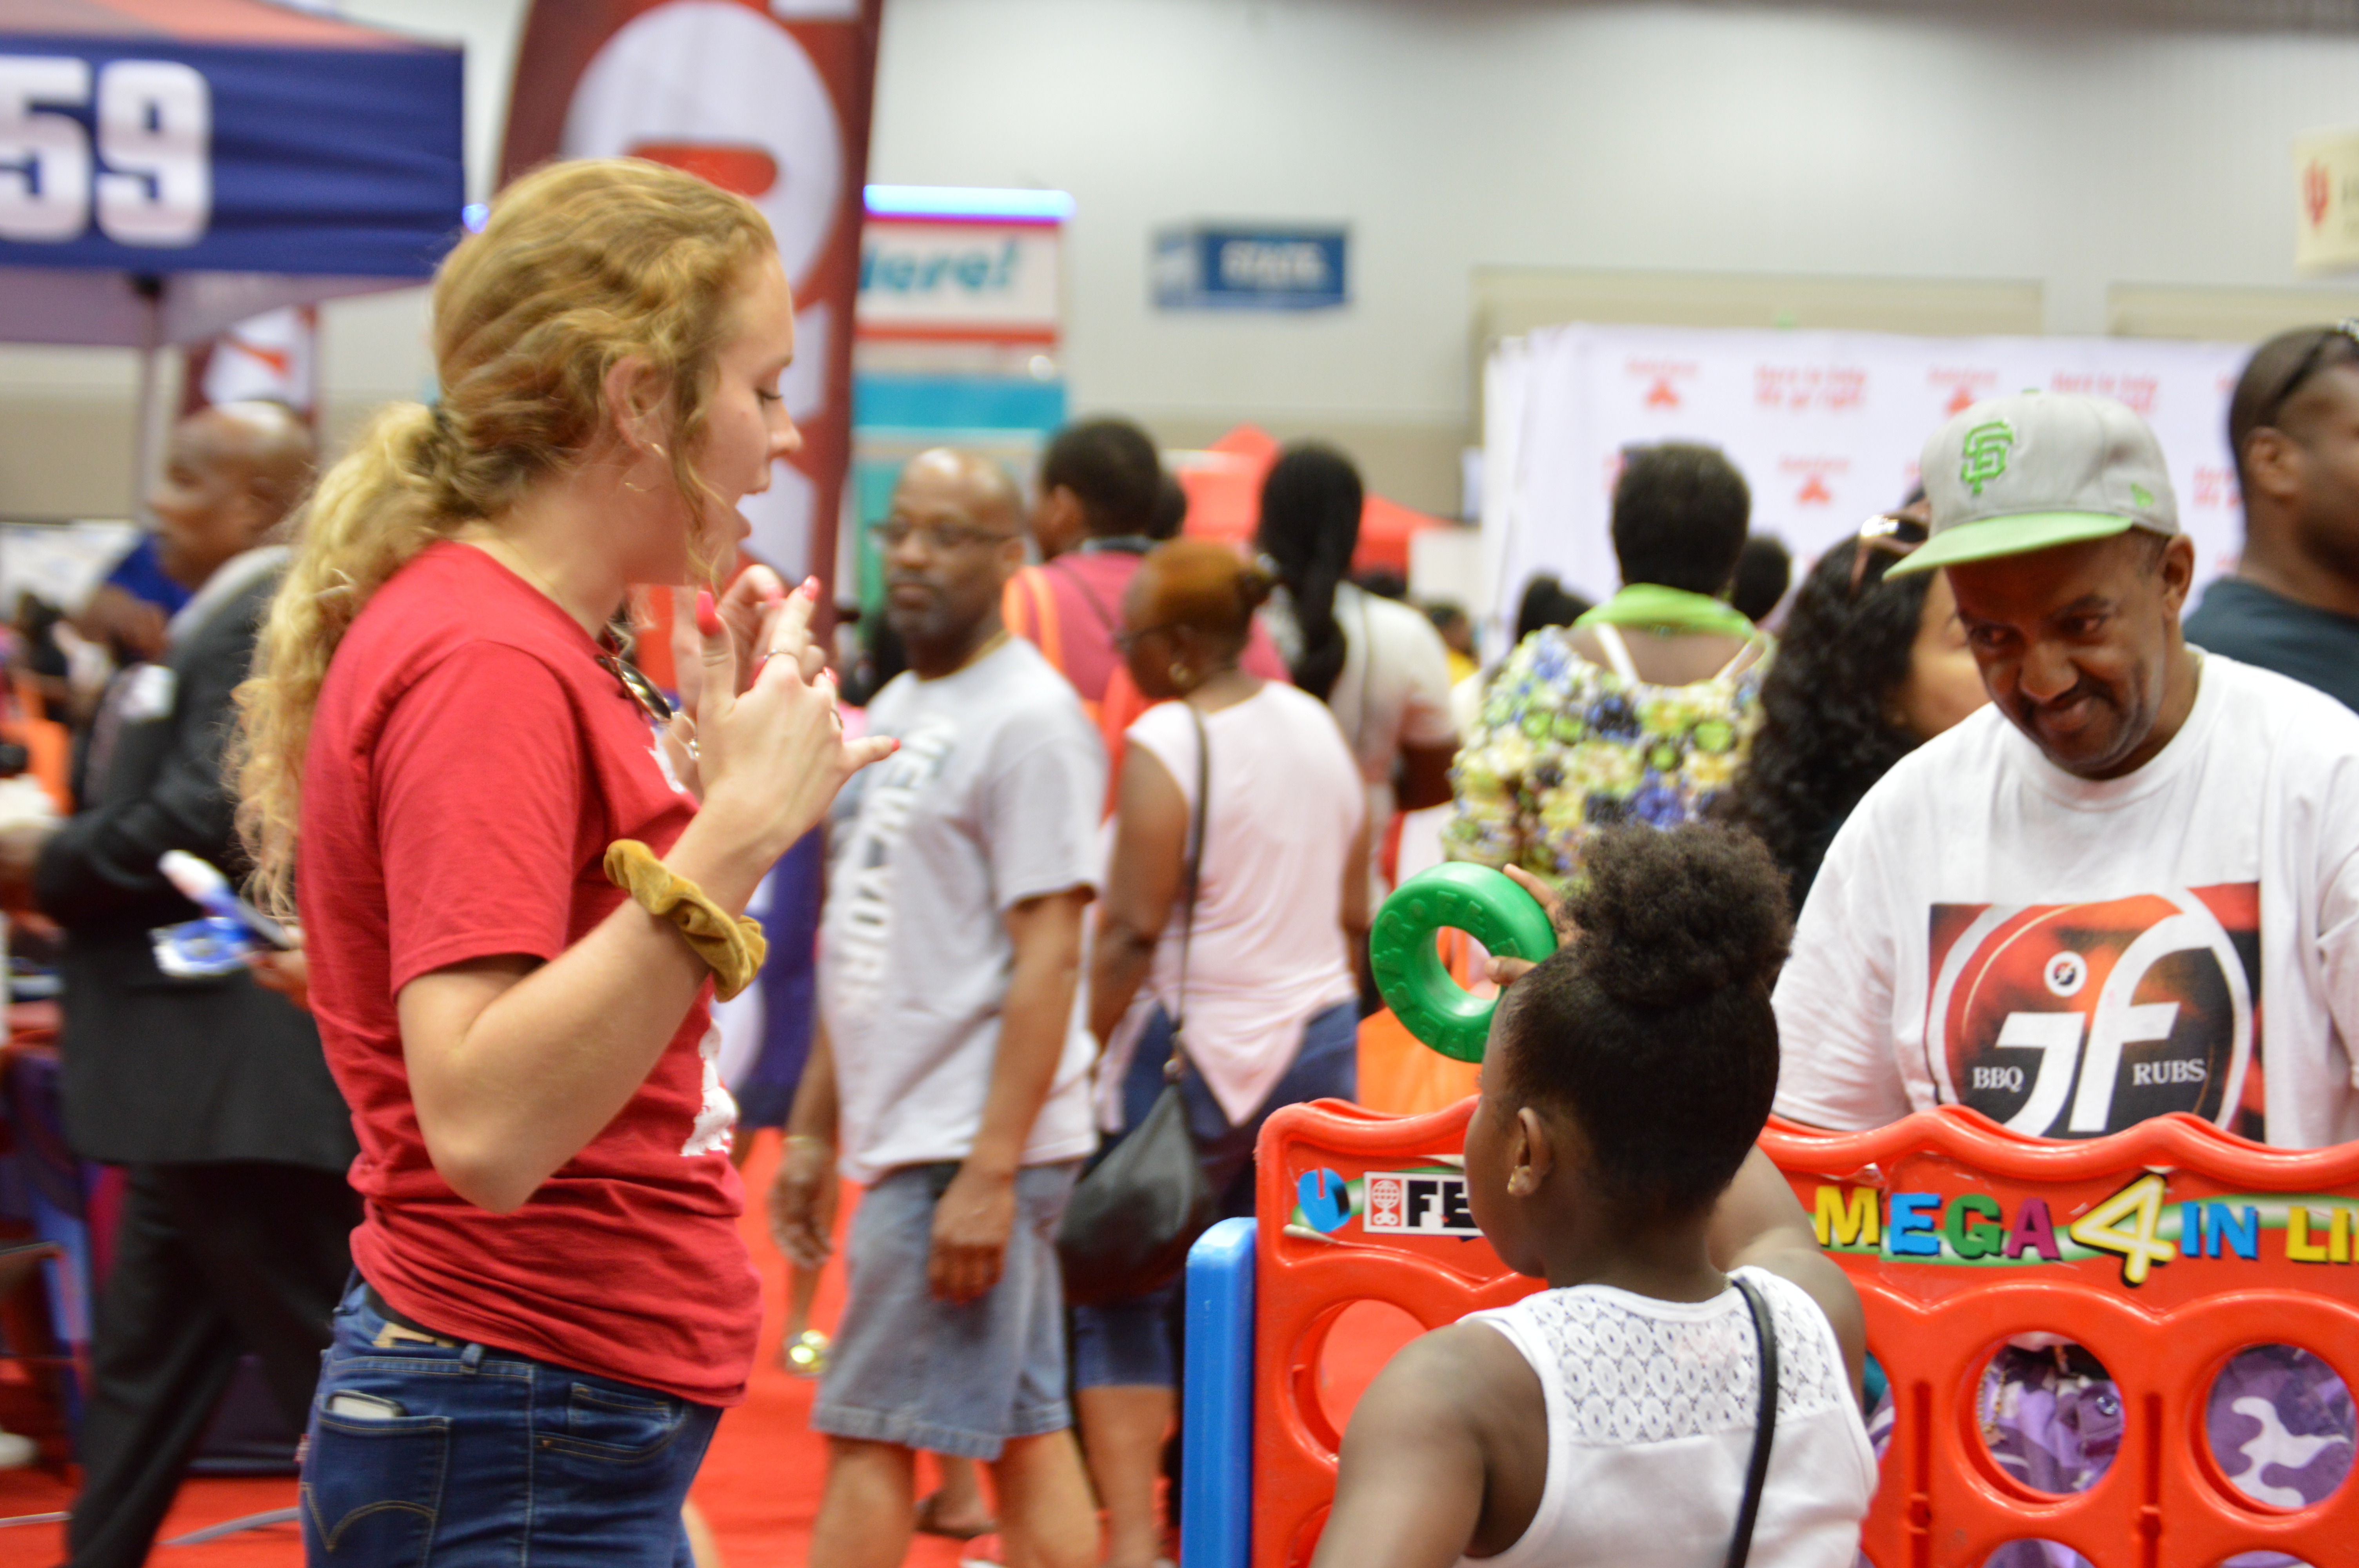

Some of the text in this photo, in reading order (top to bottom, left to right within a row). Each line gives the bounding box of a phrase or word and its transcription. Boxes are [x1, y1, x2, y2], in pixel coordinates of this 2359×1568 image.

[1972, 1065, 2025, 1092] BBQ
[2132, 1058, 2206, 1086] RUBS
[1815, 1173, 2359, 1287] MEGA 4 IN LI
